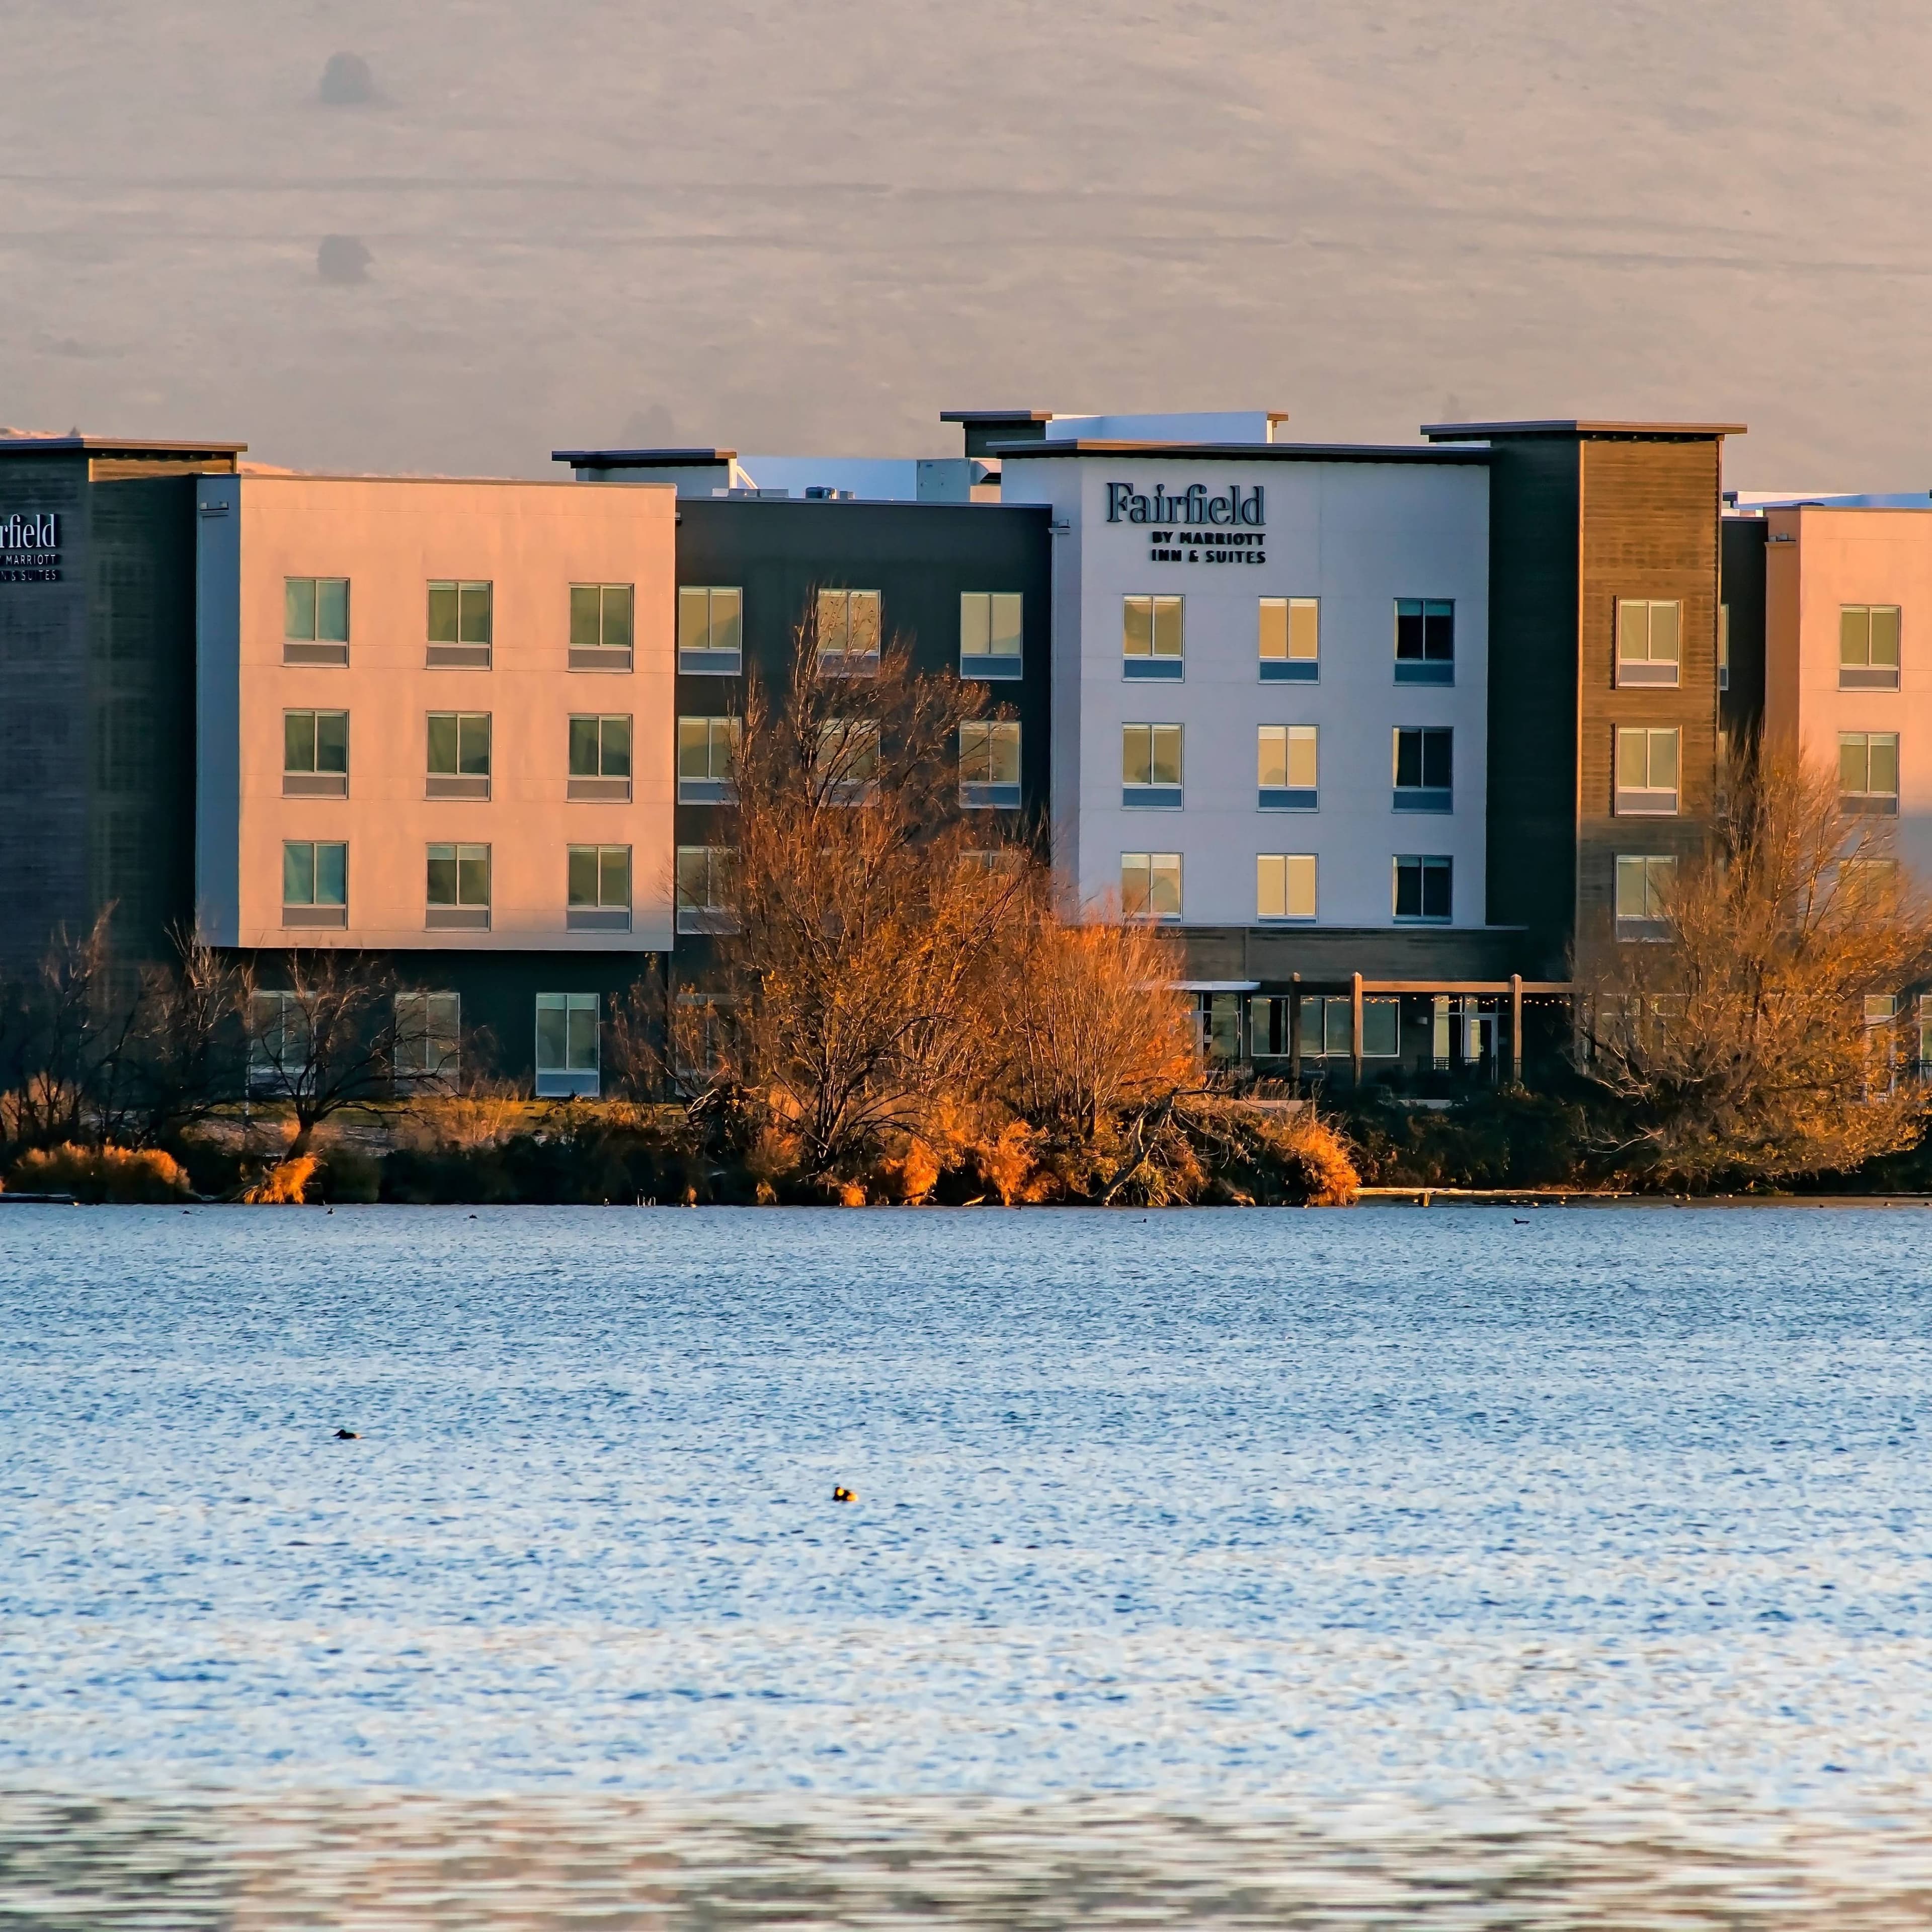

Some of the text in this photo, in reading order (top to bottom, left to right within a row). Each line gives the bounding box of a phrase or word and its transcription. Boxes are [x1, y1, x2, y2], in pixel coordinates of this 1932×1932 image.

[1106, 482, 1266, 525] Fairfield
[1152, 531, 1266, 545] BY MARRIOTT
[6, 554, 55, 565] MARRIOTT
[1152, 549, 1266, 564] INN & SUITES
[21, 570, 56, 581] SUITES
